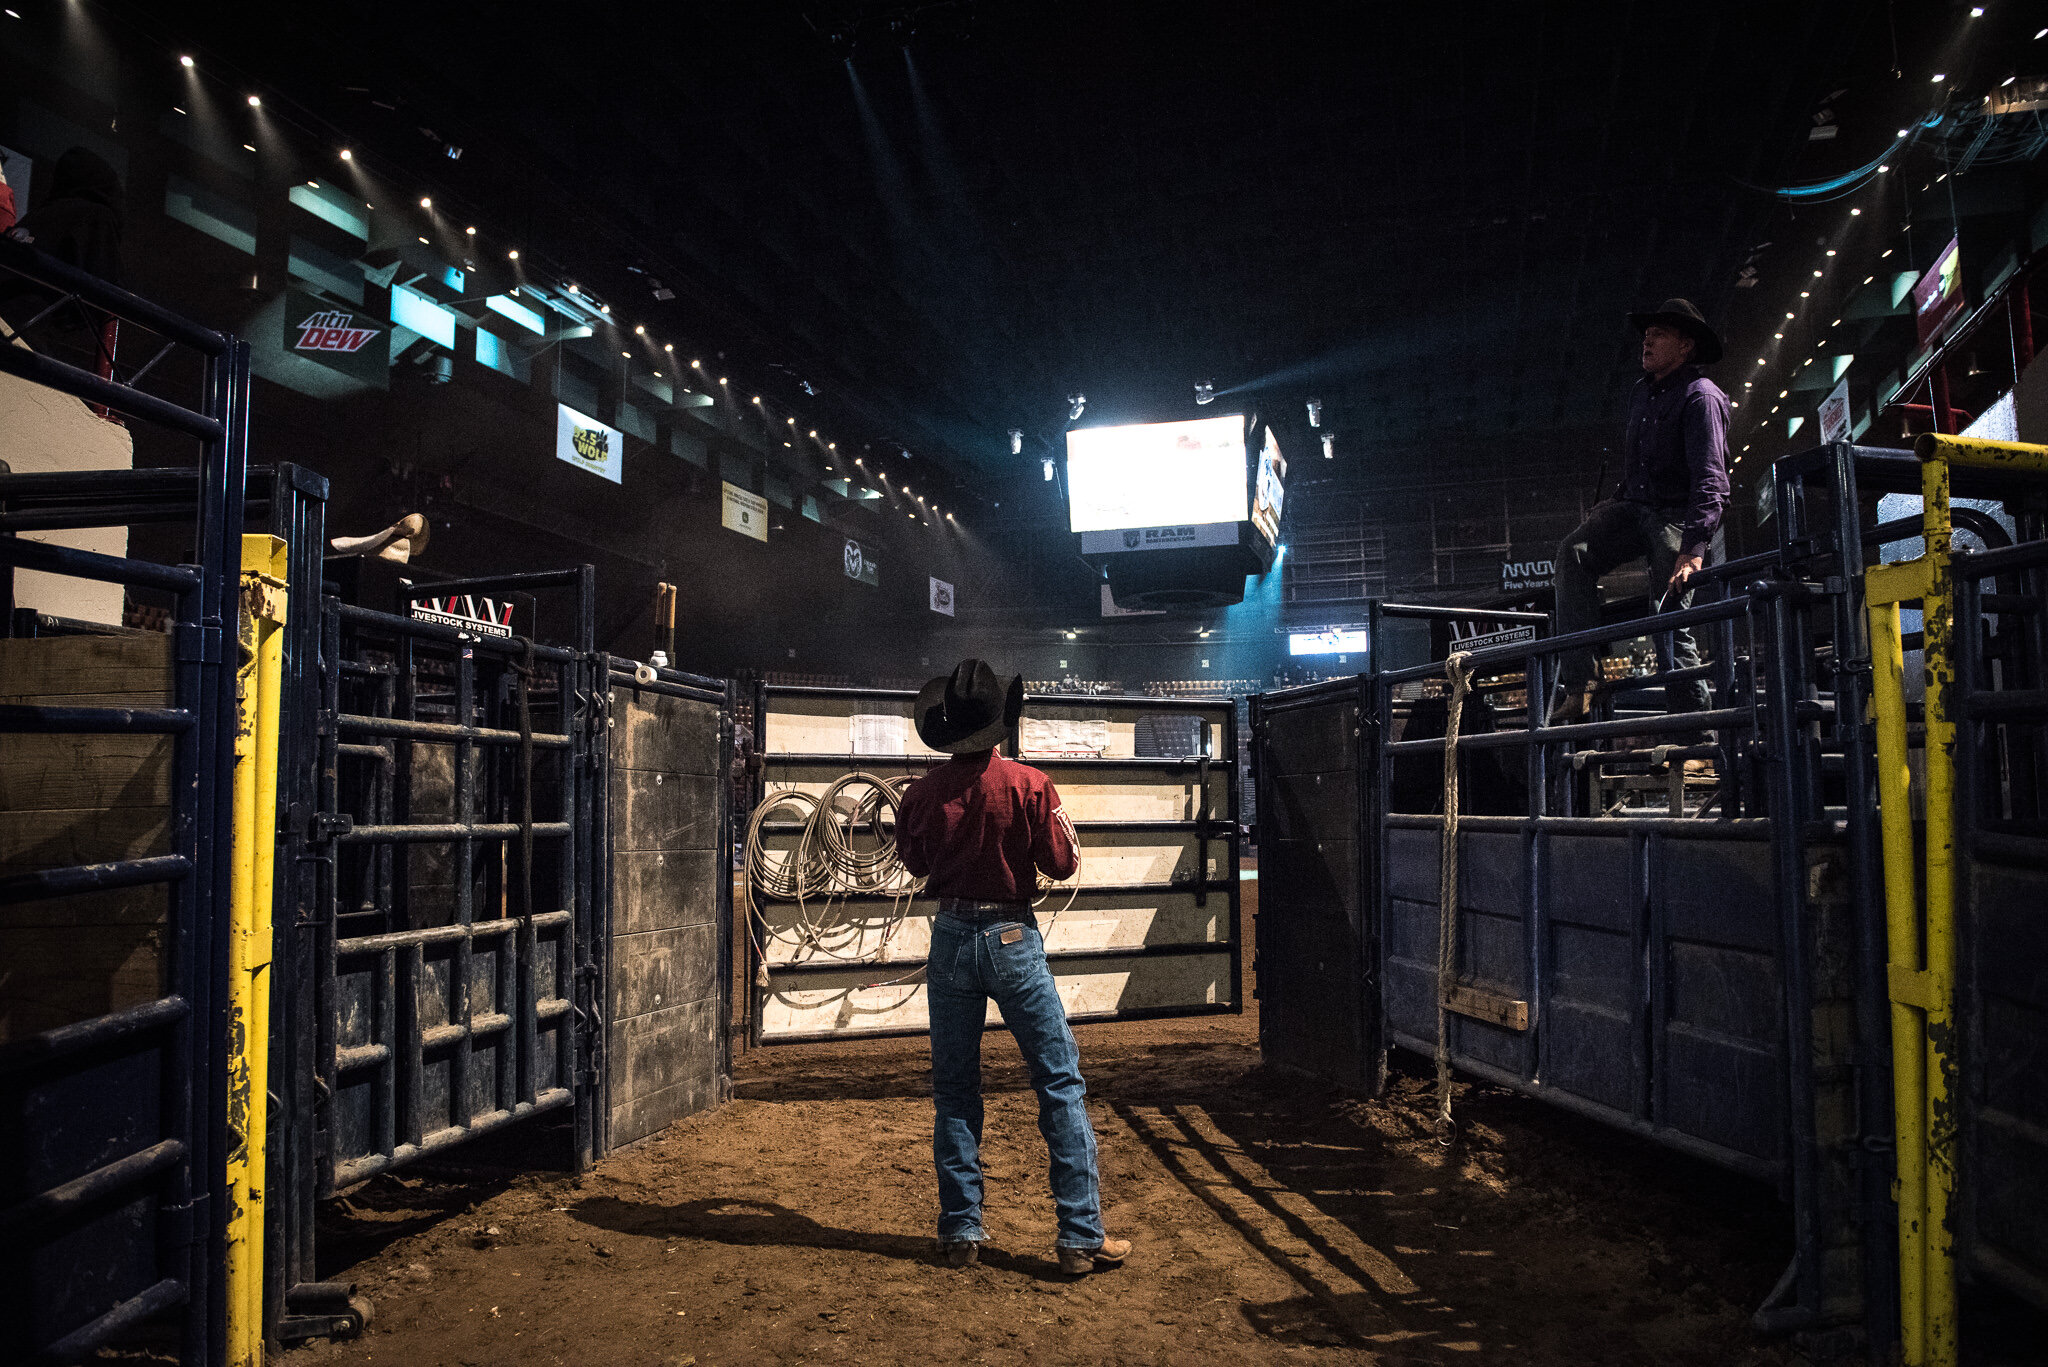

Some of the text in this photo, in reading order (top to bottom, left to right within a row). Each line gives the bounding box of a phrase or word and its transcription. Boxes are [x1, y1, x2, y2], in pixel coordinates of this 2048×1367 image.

[1145, 527, 1196, 538] RAM
[1504, 581, 1523, 590] Five
[1523, 579, 1550, 588] Years
[465, 621, 508, 637] SYSTEMS
[1454, 629, 1531, 651] LIVESTOCK SYSTEMS
